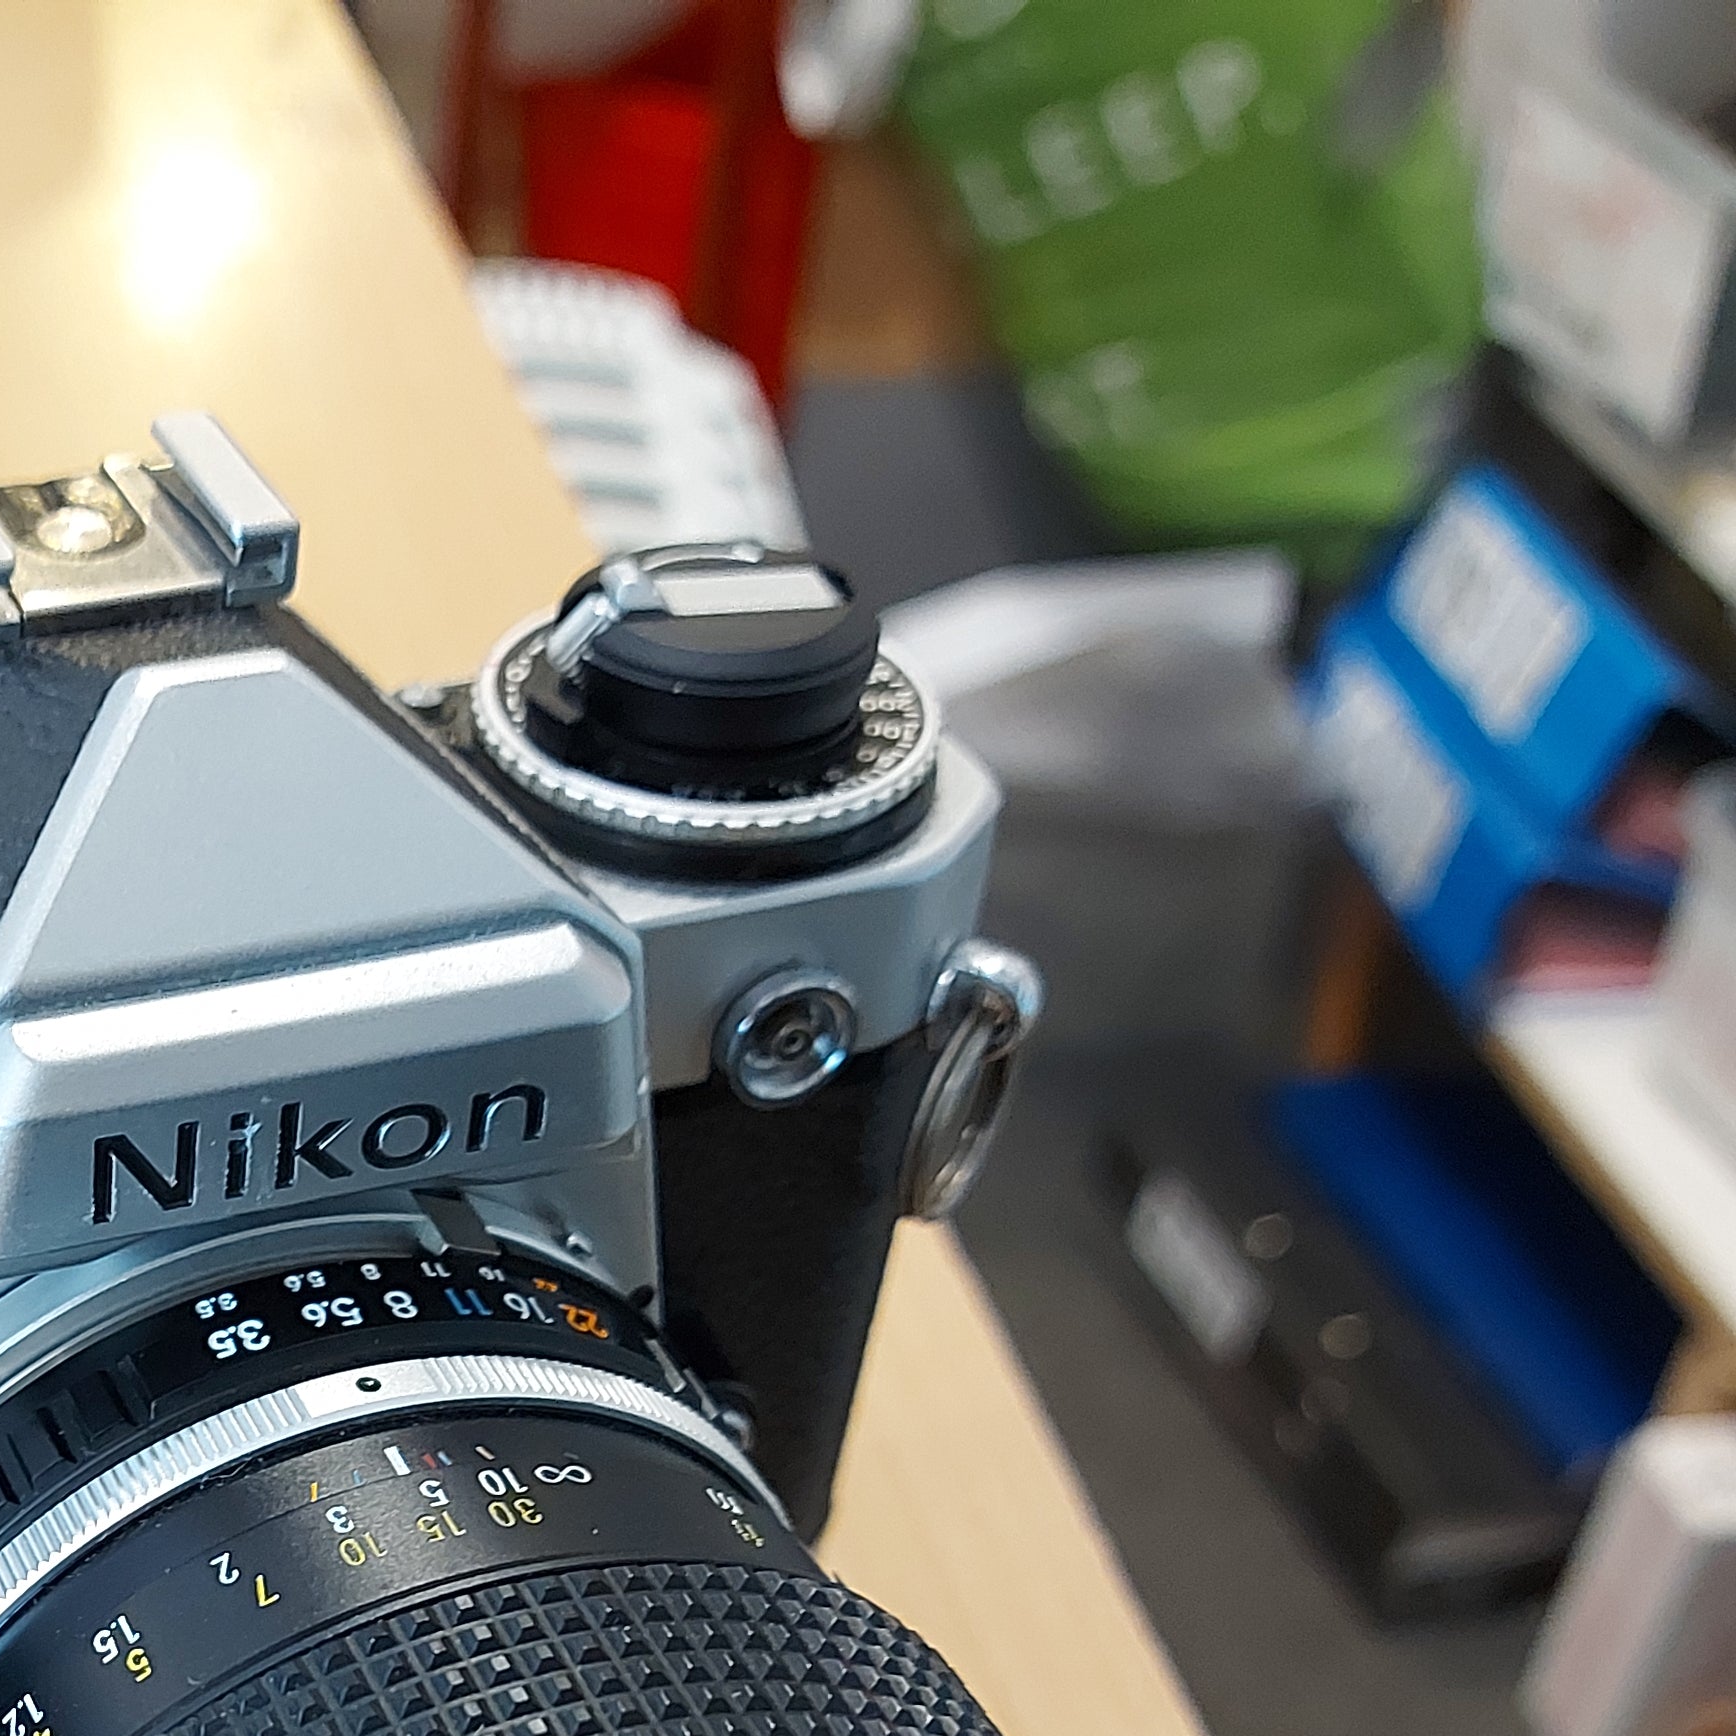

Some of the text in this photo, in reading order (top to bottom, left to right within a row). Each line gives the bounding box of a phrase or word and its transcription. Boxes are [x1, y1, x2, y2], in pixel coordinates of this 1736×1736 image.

[92, 1083, 546, 1224] Nikon
[283, 1271, 326, 1292] 5.6
[361, 1263, 381, 1280] 8
[420, 1262, 451, 1278] 11
[195, 1293, 237, 1319] 3.5
[208, 1289, 609, 1359] 22 16 11 8 5.6 3.5
[419, 1479, 450, 1508] 5
[478, 1465, 529, 1496] 10
[324, 1504, 356, 1534] 3
[417, 1512, 467, 1543] 15
[489, 1497, 543, 1528] 30
[338, 1536, 387, 1567] 10
[209, 1551, 240, 1585] 2
[253, 1574, 280, 1607] 7
[93, 1615, 140, 1664] 1.5
[125, 1648, 153, 1683] 5
